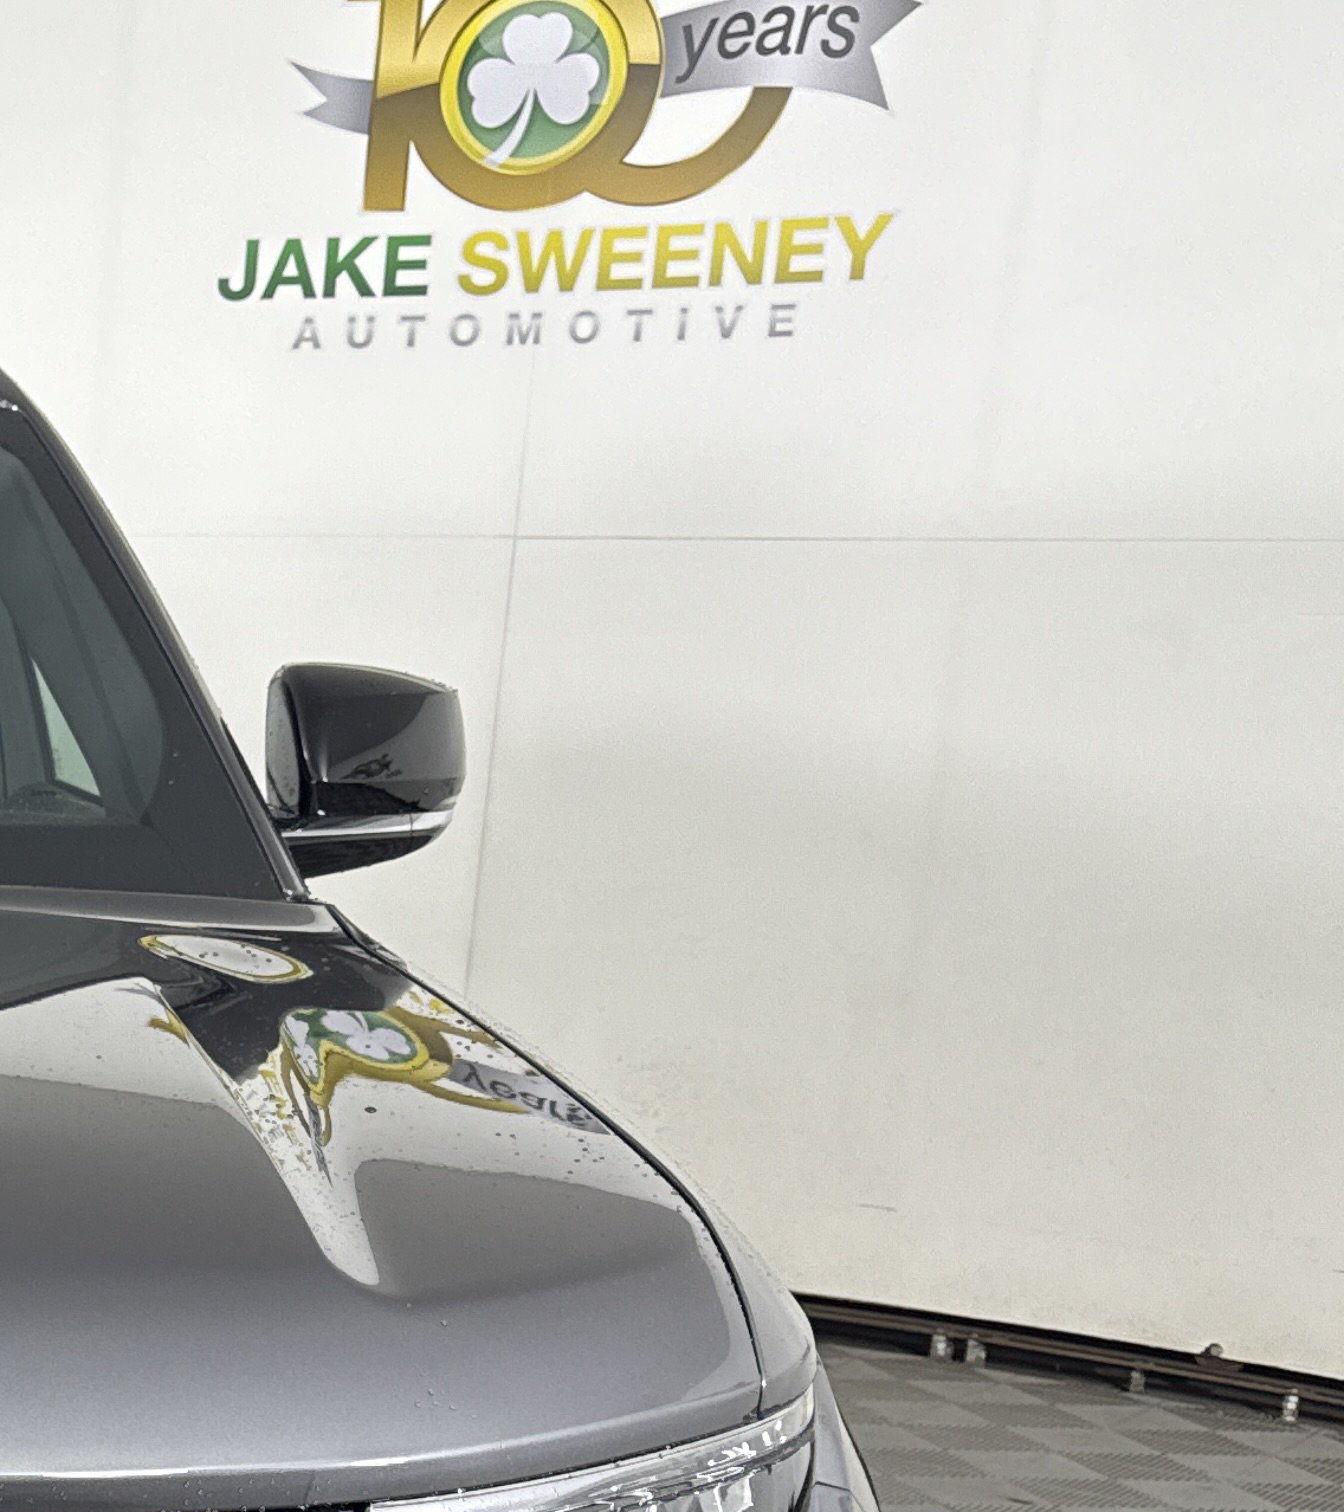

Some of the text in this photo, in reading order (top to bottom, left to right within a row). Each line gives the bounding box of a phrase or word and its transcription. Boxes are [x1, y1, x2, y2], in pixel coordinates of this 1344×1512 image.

[675, 3, 860, 82] years
[218, 212, 894, 302] JAKE SWEENEY
[291, 304, 798, 350] AUTOMOTIVE
